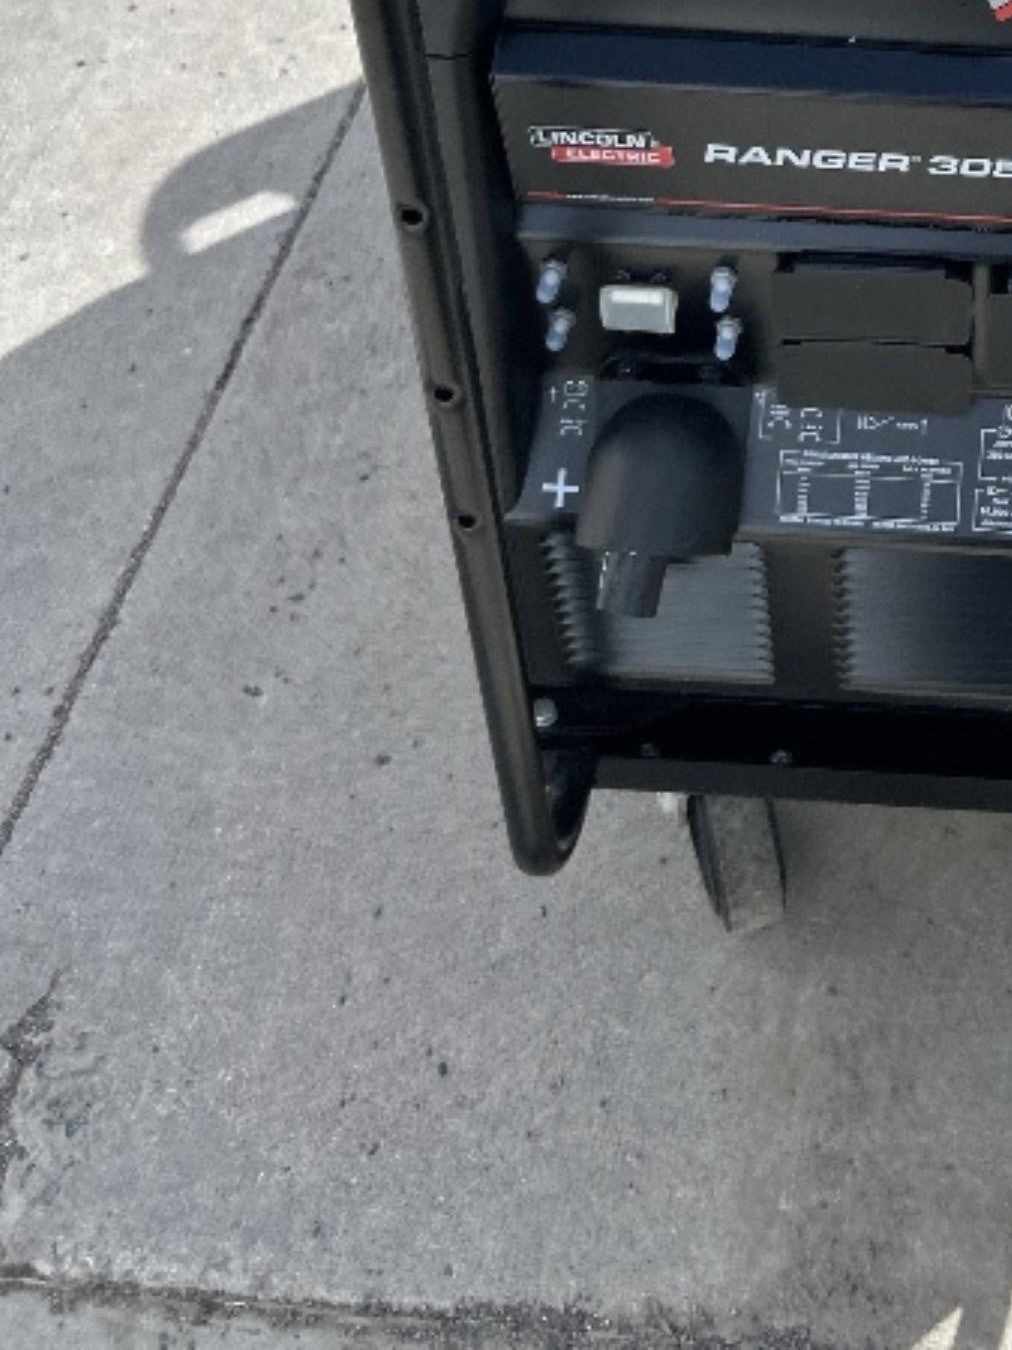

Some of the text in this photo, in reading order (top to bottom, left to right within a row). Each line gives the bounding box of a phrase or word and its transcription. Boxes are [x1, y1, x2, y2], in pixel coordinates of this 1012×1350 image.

[538, 130, 646, 148] LINCOLN
[566, 148, 661, 164] ELECTRIC
[703, 143, 911, 172] RANGER
